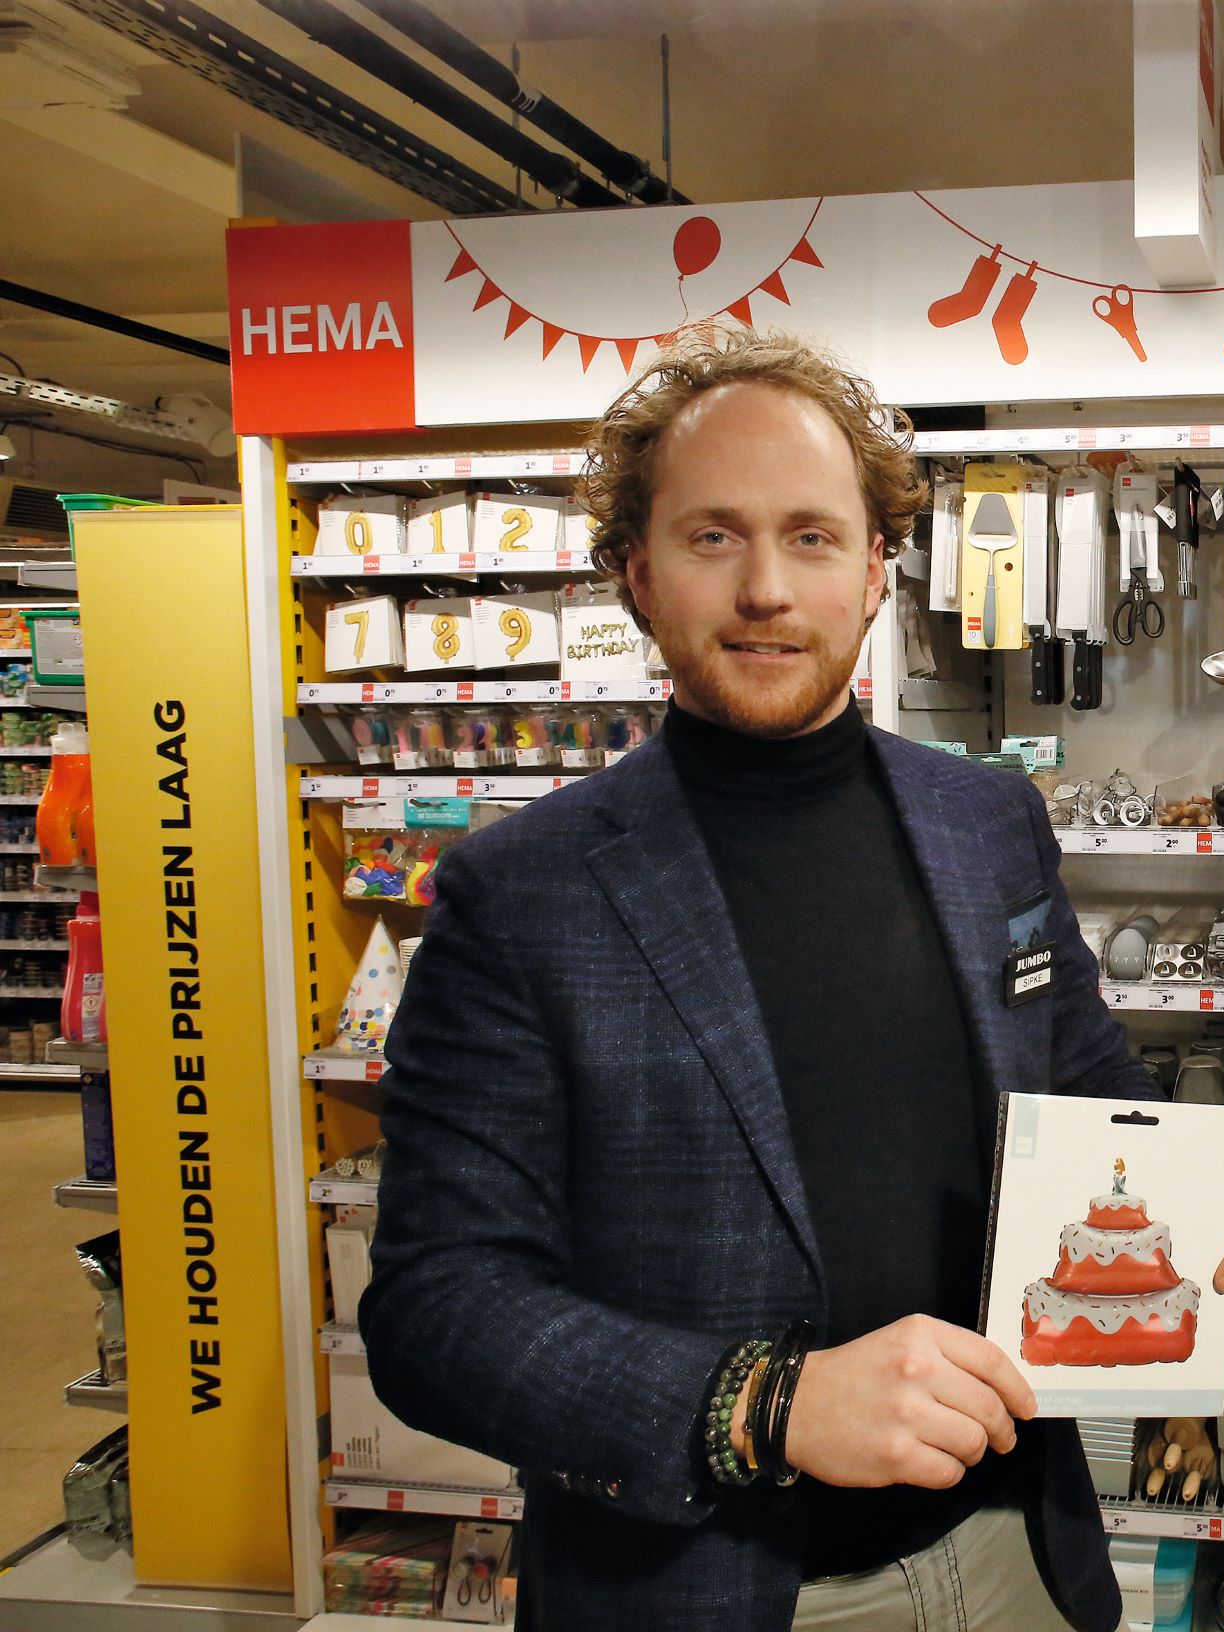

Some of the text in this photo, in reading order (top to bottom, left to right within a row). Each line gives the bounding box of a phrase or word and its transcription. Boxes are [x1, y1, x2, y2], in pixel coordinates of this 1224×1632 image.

[241, 301, 404, 356] HEMA
[455, 464, 471, 472] HEMA
[345, 510, 374, 555] 0
[429, 510, 445, 552] 1
[499, 508, 533, 551] 2
[344, 610, 370, 663] 7
[431, 612, 461, 663] 8
[498, 608, 531, 661] 9
[566, 638, 639, 660] BIRTHDAY
[580, 622, 628, 640] HAPPY
[1016, 950, 1052, 973] JUMBO
[1023, 974, 1042, 988] SIPKE
[154, 700, 222, 1415] WE HOUDEN DE PRIJZEN LAAG
